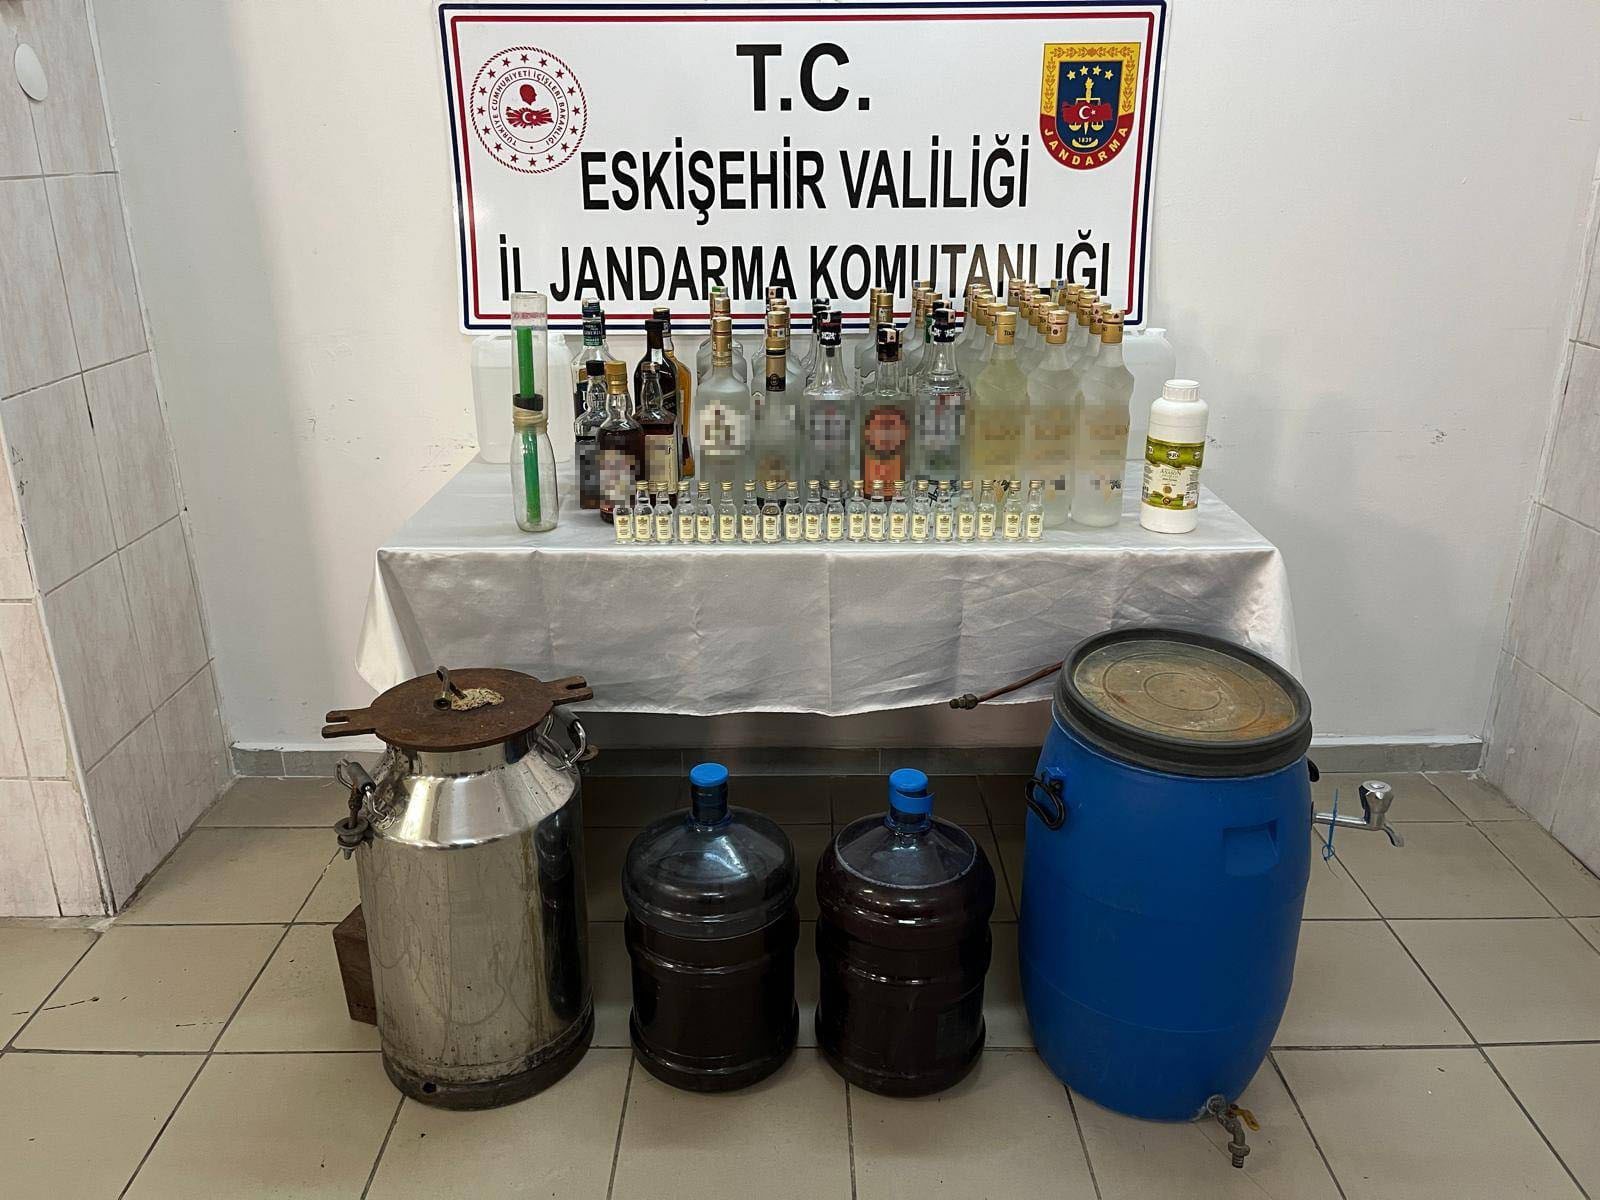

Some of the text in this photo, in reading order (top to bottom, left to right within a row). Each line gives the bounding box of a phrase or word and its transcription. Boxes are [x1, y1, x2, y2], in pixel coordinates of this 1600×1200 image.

[492, 70, 531, 111] CUMHURİYETİ
[736, 42, 870, 112] T.C.
[580, 133, 1030, 226] ESKİŞEHİR VALİLİĞİ
[1044, 126, 1128, 166] JANDARMA
[499, 229, 1110, 302] İL JANDARMA KOMUTANLIĞI
